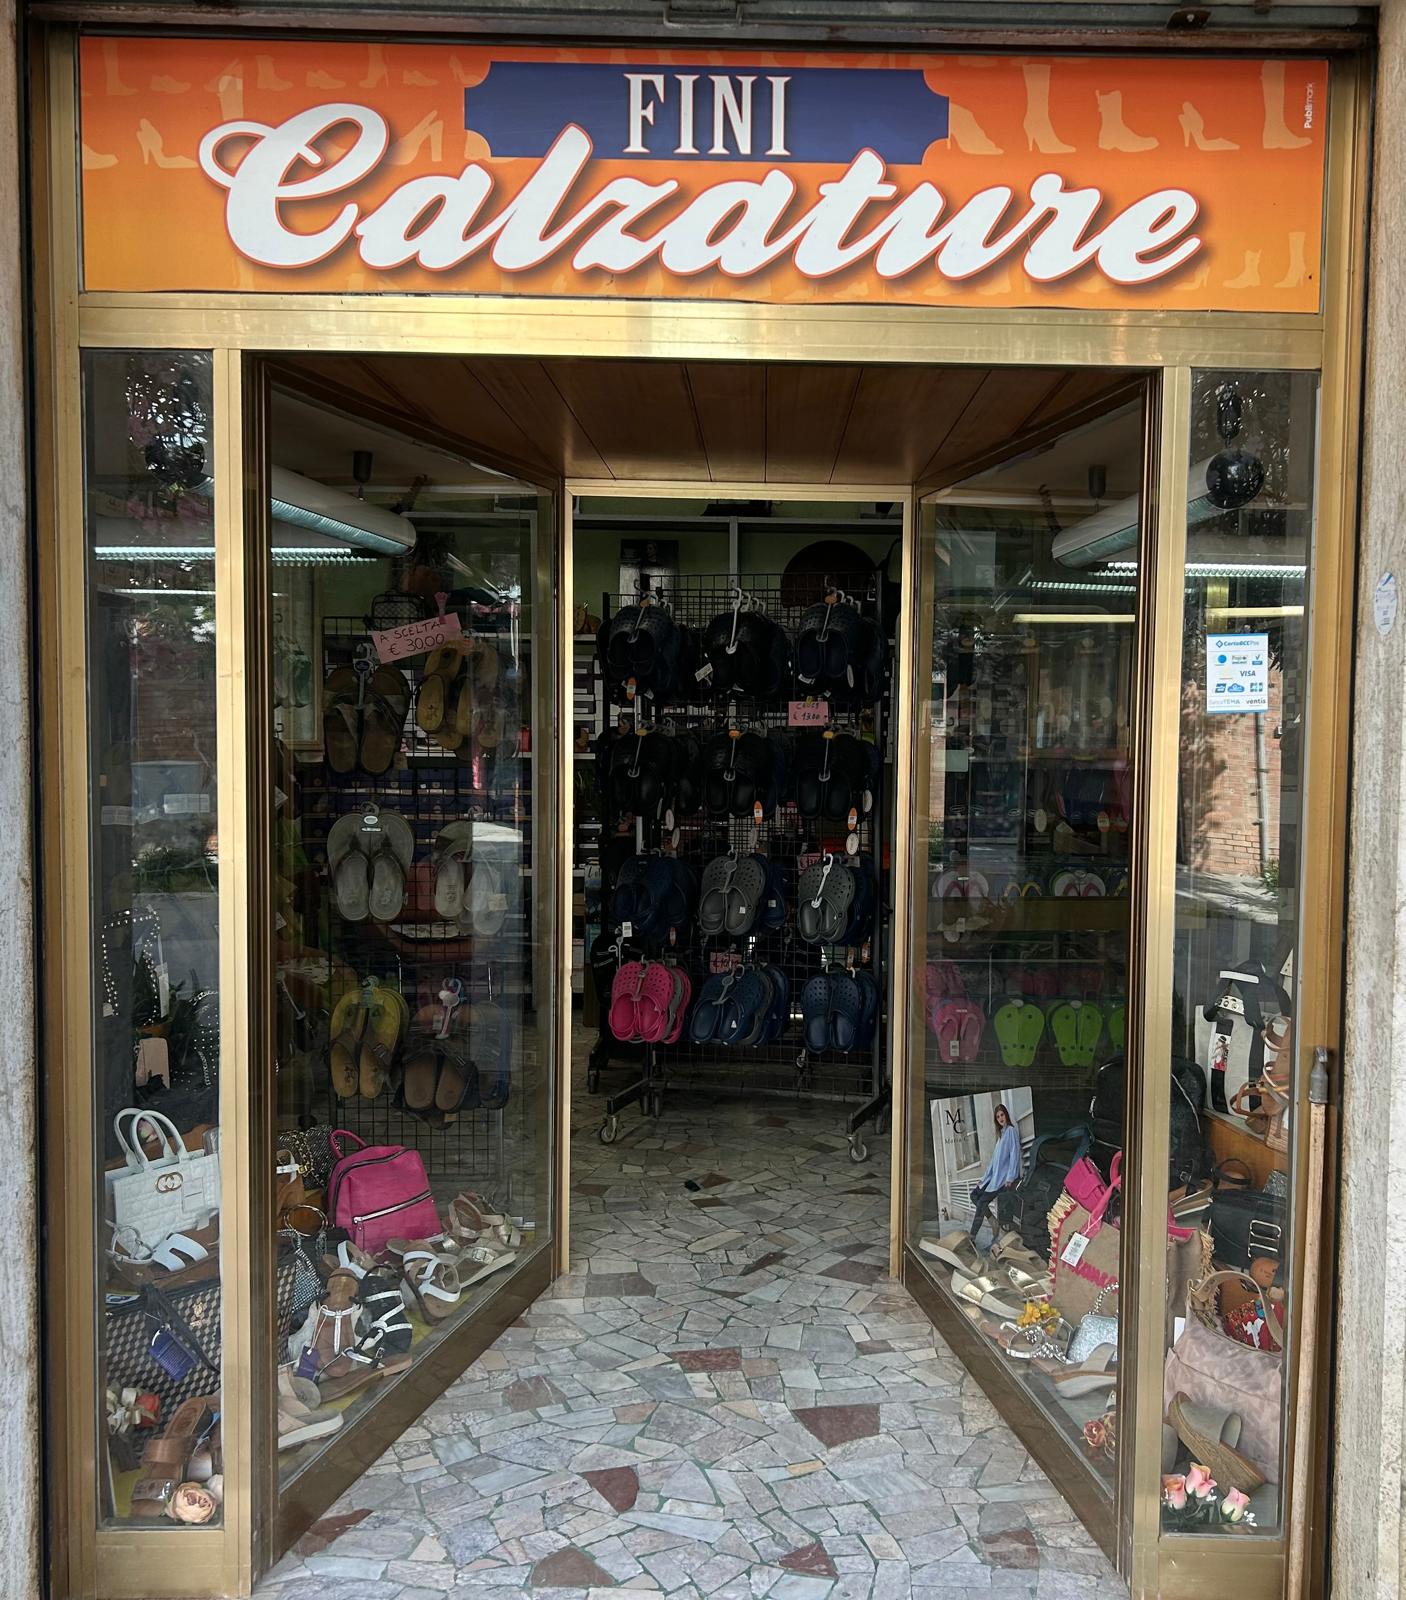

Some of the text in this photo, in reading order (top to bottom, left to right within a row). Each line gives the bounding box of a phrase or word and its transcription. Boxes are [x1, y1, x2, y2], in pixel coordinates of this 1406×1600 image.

[623, 72, 792, 157] FINI
[198, 102, 1202, 285] Calzature
[380, 621, 441, 643] A SCELTA
[388, 634, 444, 656] € 30,00
[1246, 697, 1266, 705] ventis
